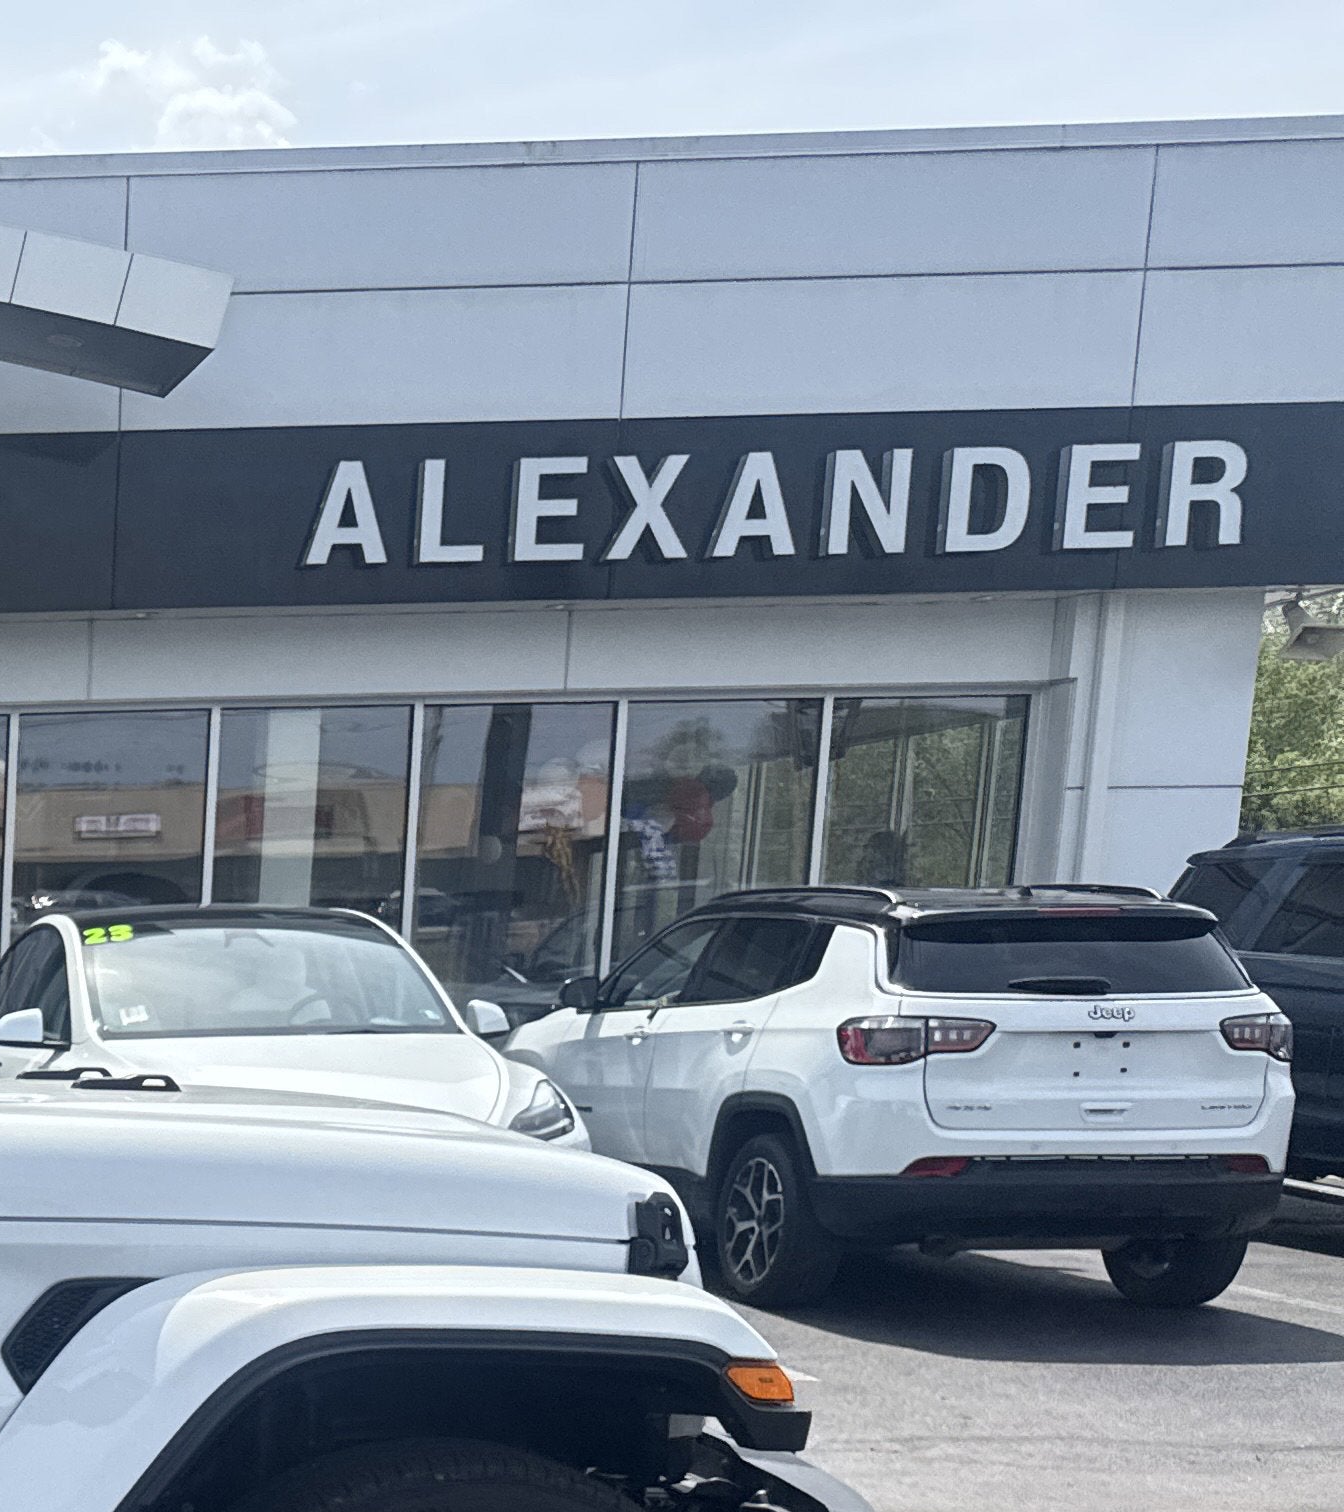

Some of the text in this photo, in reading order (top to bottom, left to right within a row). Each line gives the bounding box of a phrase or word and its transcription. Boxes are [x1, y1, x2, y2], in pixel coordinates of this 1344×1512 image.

[301, 440, 1249, 566] ALEXANDER
[82, 924, 134, 945] 23
[1087, 1004, 1136, 1022] Jeep
